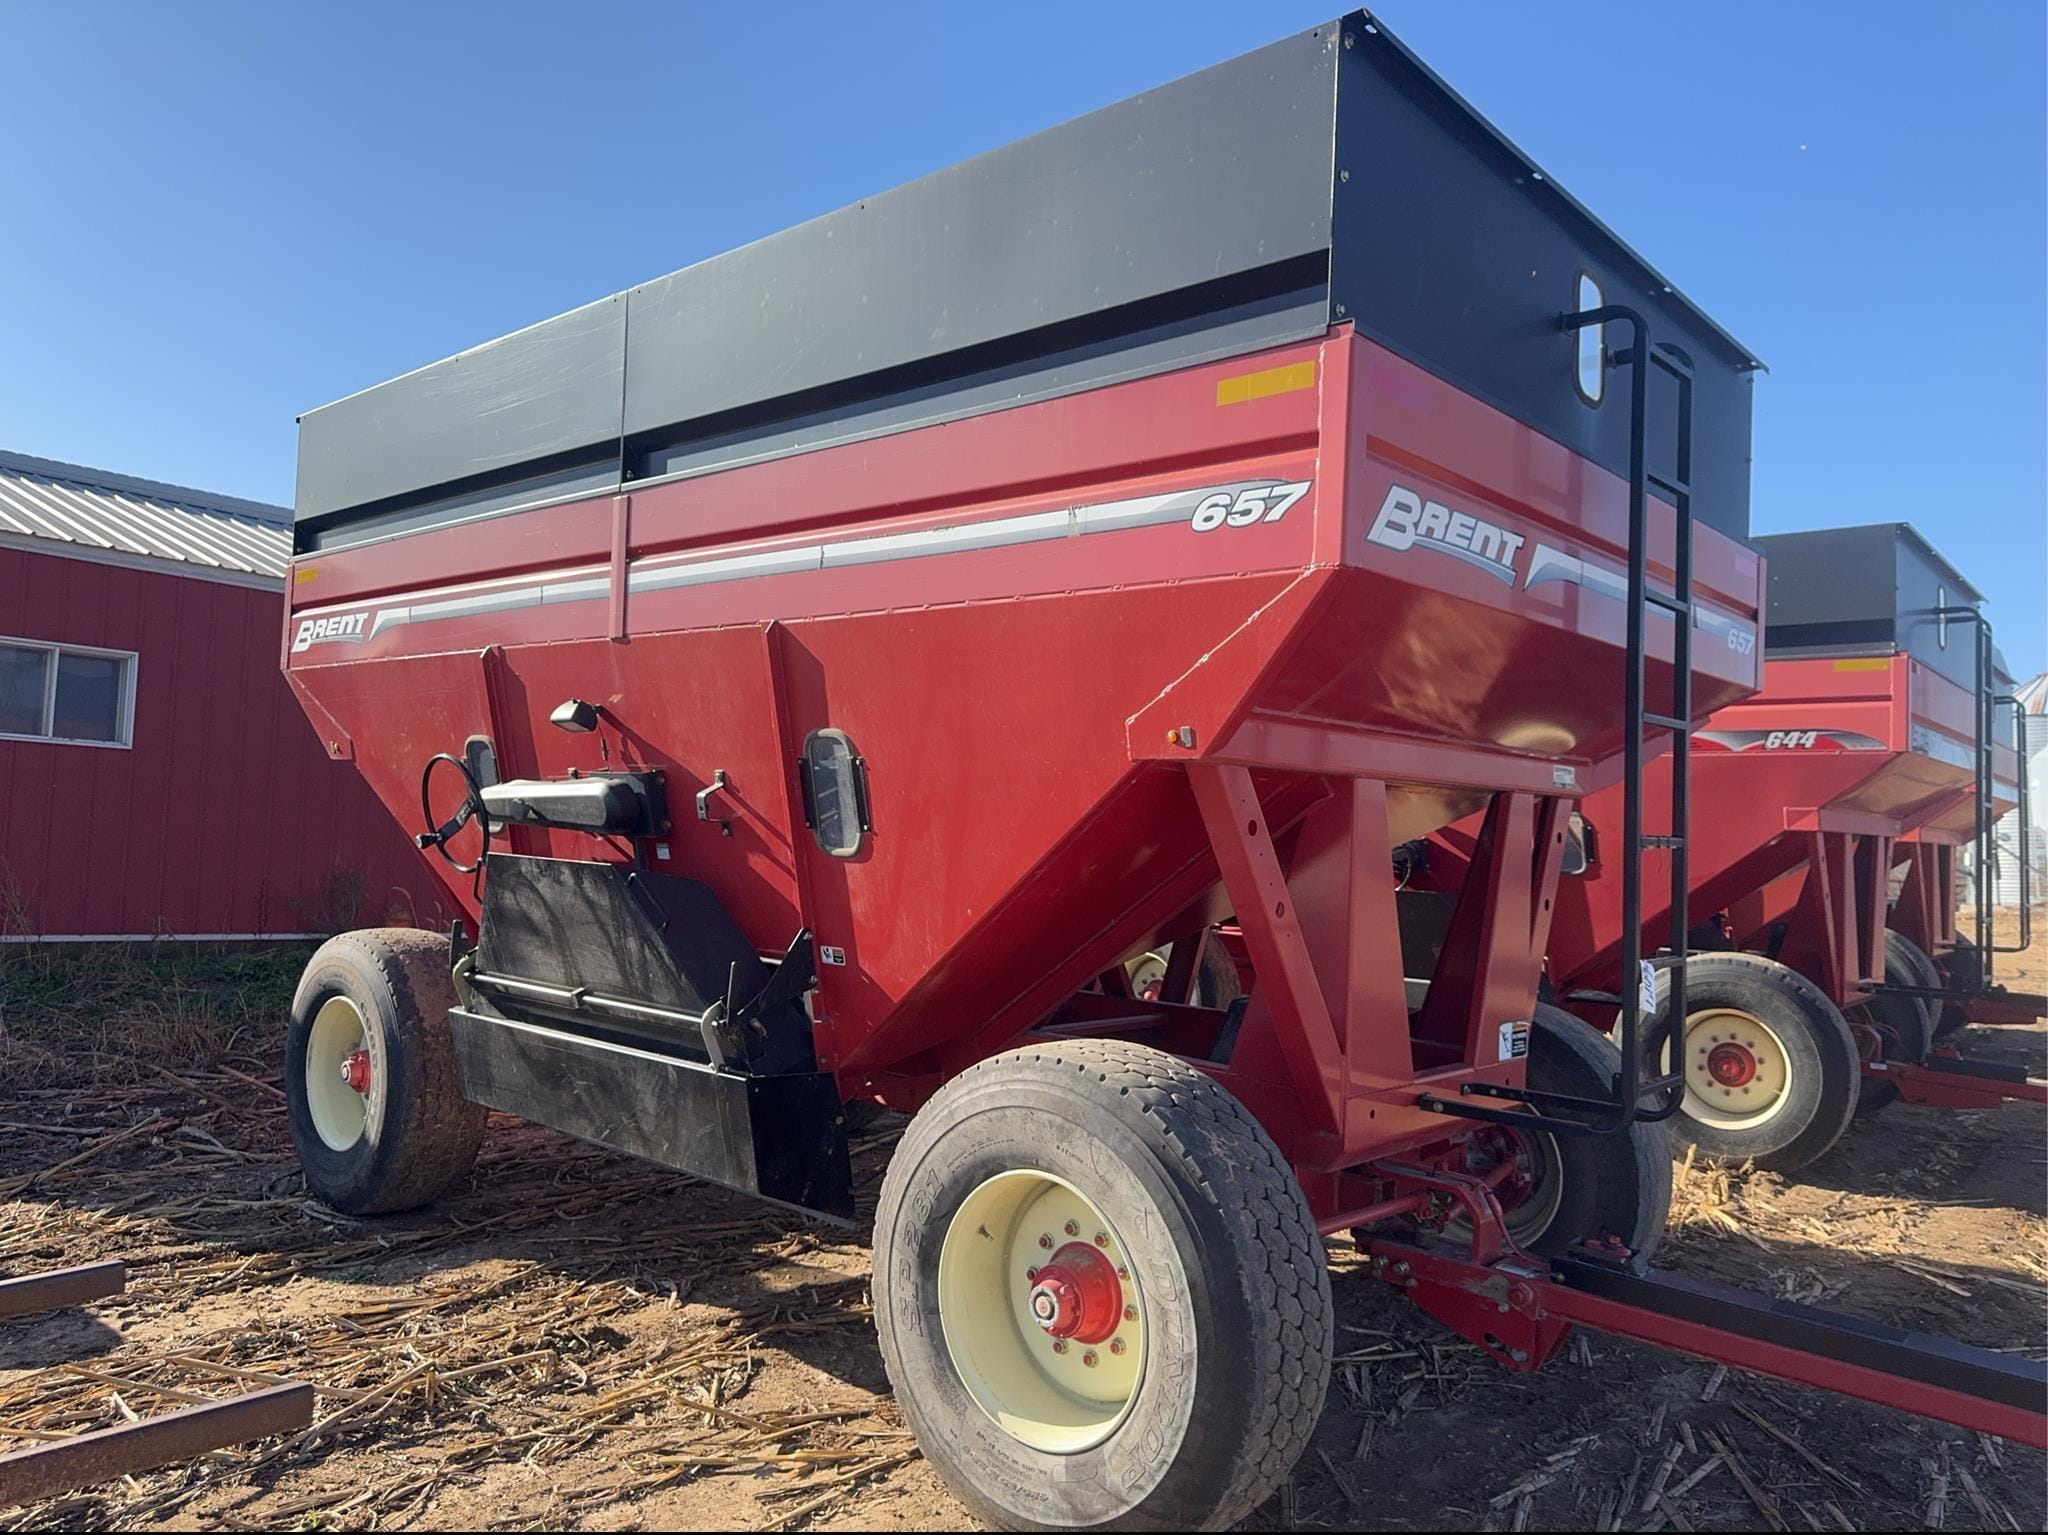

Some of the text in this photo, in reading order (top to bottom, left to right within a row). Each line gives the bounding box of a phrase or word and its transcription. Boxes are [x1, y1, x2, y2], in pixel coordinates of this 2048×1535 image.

[1191, 479, 1315, 533] 657
[1364, 483, 1526, 570] BRENT
[290, 612, 369, 653] BRENT
[1727, 626, 1755, 656] 657
[1764, 730, 1818, 749] 644
[903, 1167, 945, 1258] 281
[1121, 1254, 1184, 1490] DUNLOP
